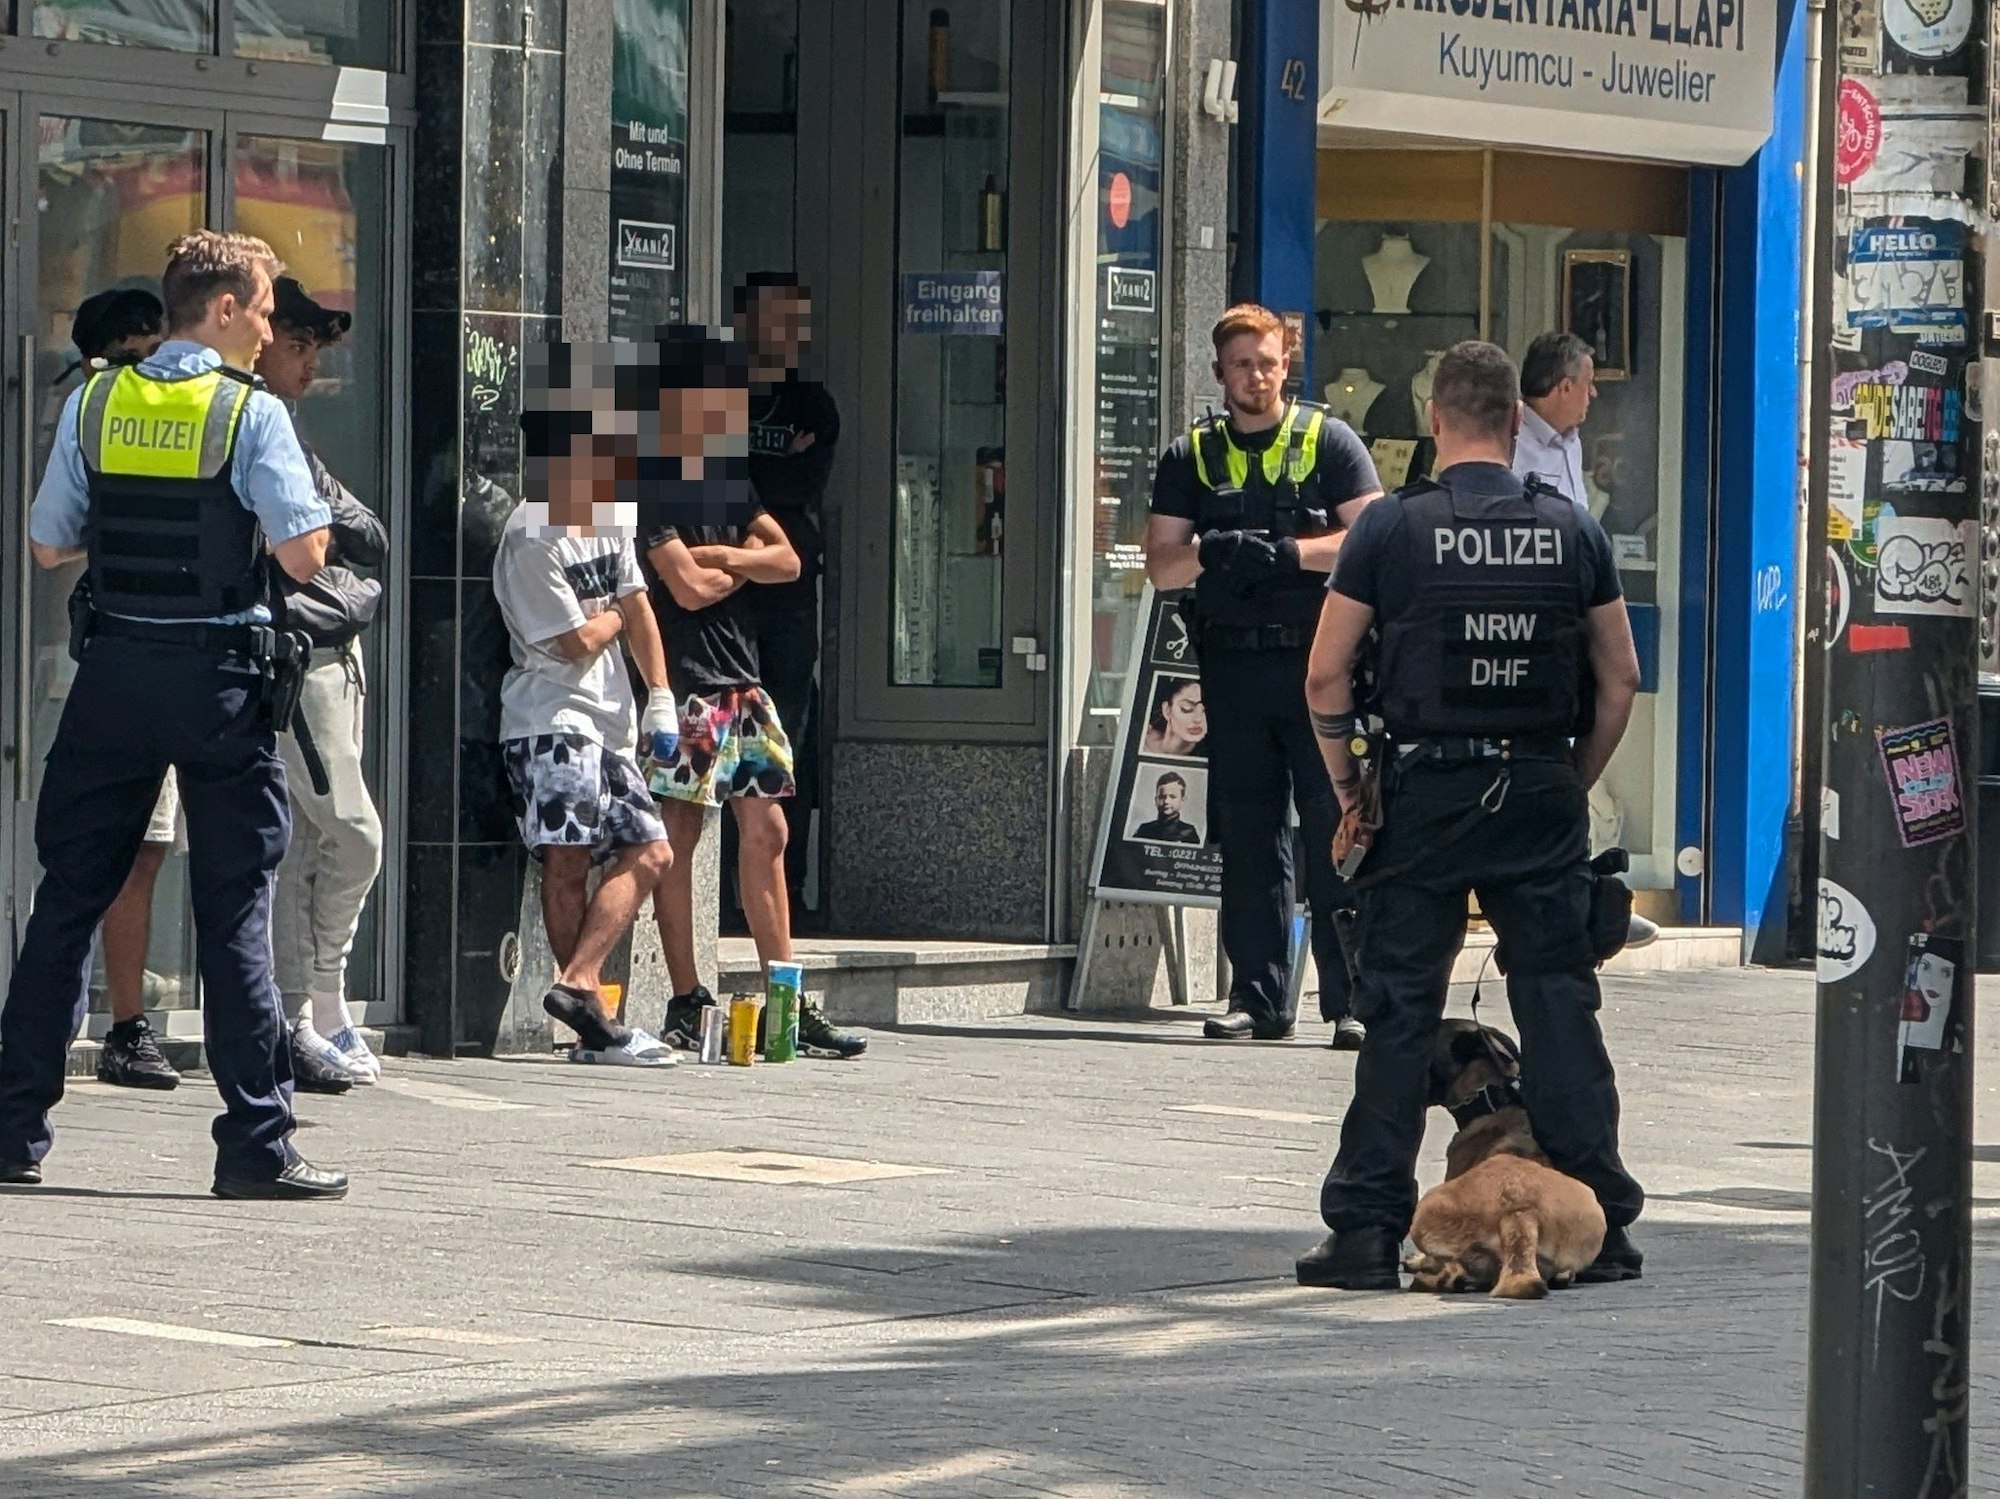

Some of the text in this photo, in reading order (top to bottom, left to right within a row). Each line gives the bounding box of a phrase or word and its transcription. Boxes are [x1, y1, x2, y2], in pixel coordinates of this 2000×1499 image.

[1395, 0, 1745, 51] ARIA-LLAPI
[1280, 58, 1306, 101] 42
[1438, 31, 1573, 91] Kuyumcu
[1602, 51, 1716, 103] Juwelier
[629, 120, 668, 145] Mit und
[615, 147, 681, 174] Ohne Termin
[1869, 233, 1937, 252] HELLO
[917, 279, 1001, 303] Eingang
[905, 303, 1004, 325] freihalten
[107, 415, 196, 452] POLIZEI
[1434, 527, 1564, 566] POLIZEI
[1464, 613, 1537, 642] NRW
[1470, 657, 1530, 687] DHF
